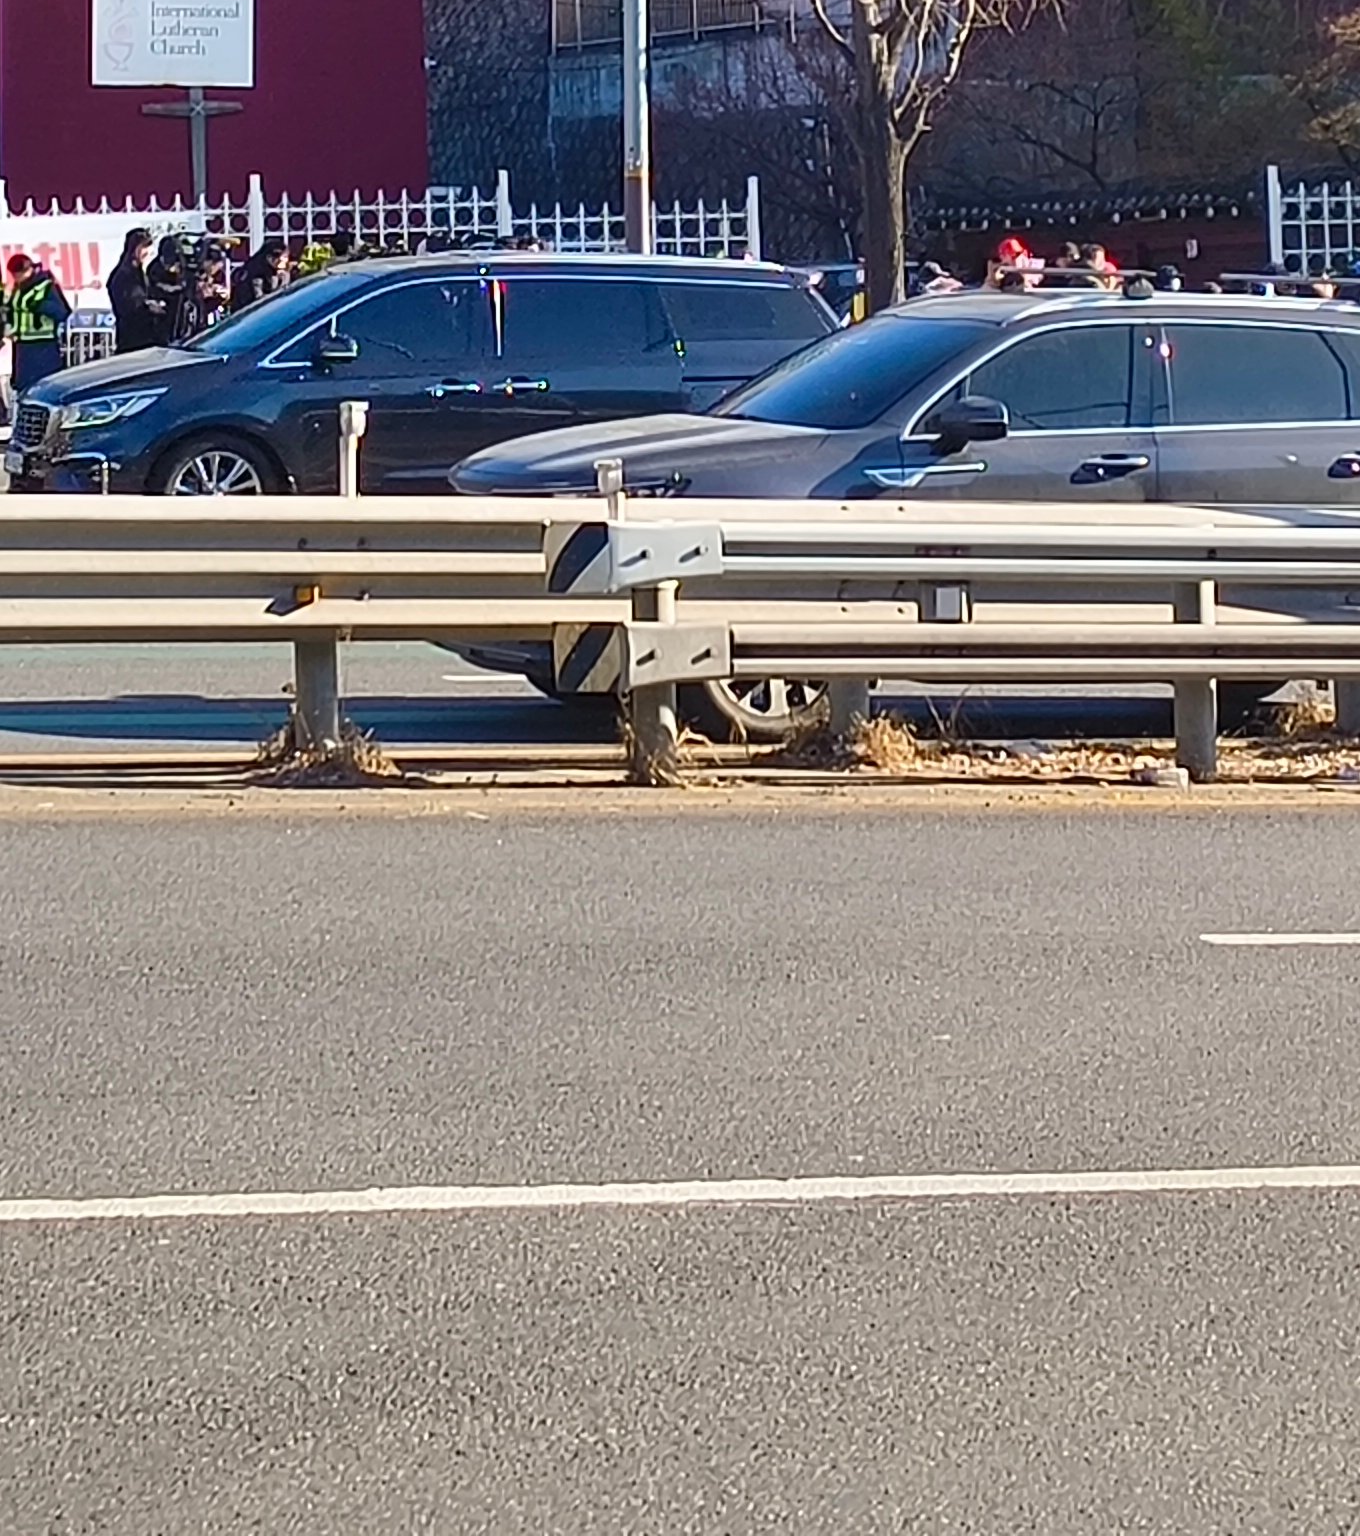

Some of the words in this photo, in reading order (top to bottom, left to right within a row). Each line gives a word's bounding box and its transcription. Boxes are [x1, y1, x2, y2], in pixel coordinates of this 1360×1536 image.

[150, 0, 240, 18] International
[150, 19, 219, 37] Lutheran
[149, 38, 206, 56] Church
